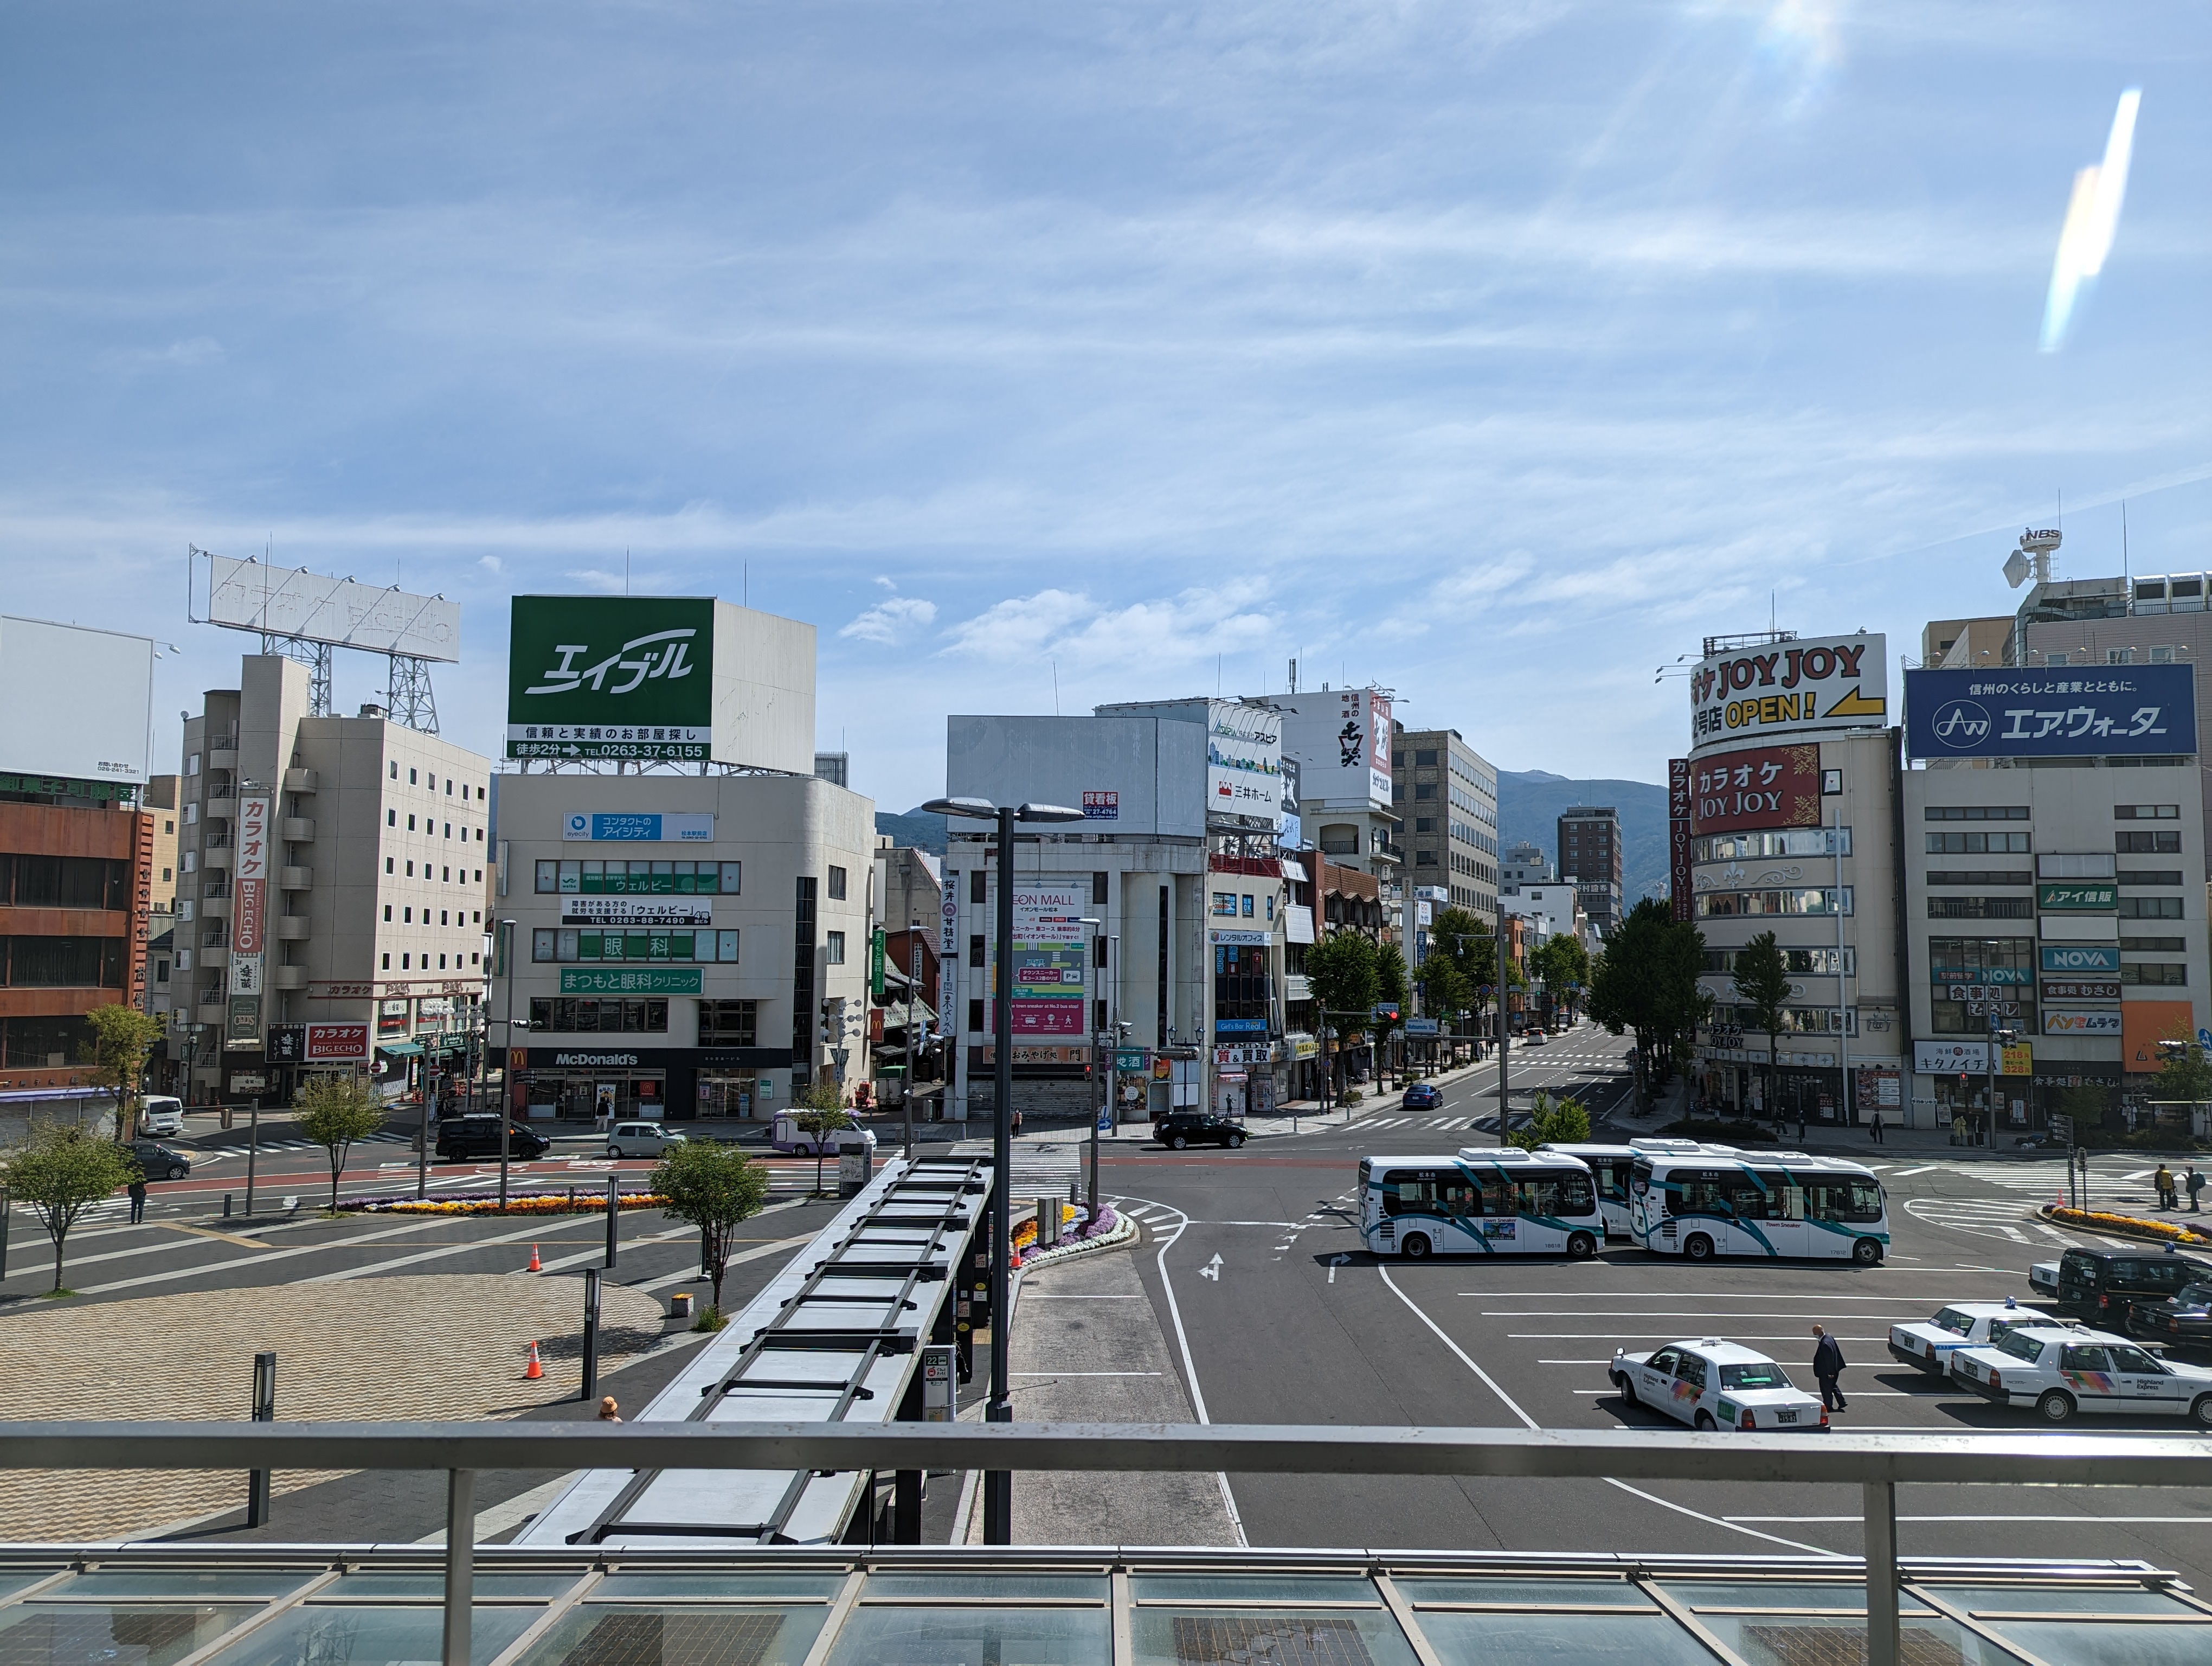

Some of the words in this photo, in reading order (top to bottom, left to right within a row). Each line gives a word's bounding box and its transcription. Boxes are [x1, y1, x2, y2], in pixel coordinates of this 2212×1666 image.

[2026, 529, 2060, 541] NBS
[524, 629, 697, 695] エイブル
[1716, 652, 1779, 701] JOY
[1782, 644, 1866, 689] JOY
[1969, 680, 2138, 696] 信州のくらしと産業とともに。
[1351, 693, 1359, 717] 信州の
[1693, 705, 1723, 738] 2号店
[1725, 691, 1817, 729] OPEN!
[525, 726, 697, 741] 信頼と実績のお部屋探し
[1238, 730, 1255, 739] 株式会社
[1254, 731, 1277, 745] アスピア
[516, 743, 561, 756] 徒歩2分
[584, 748, 599, 756] TEL
[601, 745, 703, 758] 0263-37-6155
[97, 766, 140, 774] 026-241-3321
[1699, 760, 1784, 796] カラオケ
[1234, 785, 1272, 803] 三井ホーム
[1672, 760, 1687, 817] カラオケ
[1084, 792, 1117, 805] 貸看板
[1697, 796, 1729, 821] JOY
[1732, 790, 1783, 816] JOY
[602, 817, 651, 825] コンタクトの
[242, 802, 265, 875] カラオケ
[602, 826, 651, 838] アイシティ
[1675, 821, 1686, 853] JOY
[1675, 854, 1687, 886] JOY
[616, 881, 672, 892] ウェルビー
[943, 879, 956, 902] 桜井
[242, 881, 256, 907] BIG
[1012, 894, 1037, 905] EON
[1041, 895, 1075, 905] MALL
[2057, 891, 2112, 902] アイ信販
[631, 905, 694, 916] 「ウェルビー」
[240, 910, 254, 949] ECHO
[1220, 934, 1263, 943] レンタルオフィス
[605, 937, 623, 956] 眼
[650, 937, 669, 956] 科
[1217, 946, 1225, 974] iPhone
[1228, 945, 1238, 962] 修理
[2054, 951, 2110, 968] NOVA
[873, 932, 884, 992] まつもと眼科クリニック
[564, 974, 699, 991] まつもと眼科クリニック
[1941, 972, 1973, 980] 駅前留学
[1982, 970, 2026, 983] NOVA
[330, 985, 372, 995] カラオケ
[1952, 986, 2001, 999] 食事処
[2047, 985, 2077, 995] 食事処
[2081, 984, 2117, 996] むさし
[1970, 1003, 2017, 1016] むさし
[1245, 1021, 1261, 1030] Real
[1708, 1023, 1742, 1036] カラオケ
[313, 1028, 364, 1039] カラオケ
[1708, 1035, 1722, 1047] JOY
[1723, 1036, 1742, 1048] JOY
[312, 1045, 332, 1055] BIG
[334, 1045, 363, 1053] ECHO
[1012, 1050, 1058, 1060] おみやげ処
[1069, 1048, 1081, 1062] 門
[1935, 1046, 1980, 1056] 海鮮肉酒場
[2003, 1051, 2030, 1059] 218円
[555, 1053, 638, 1066] McDonald's
[2004, 1065, 2030, 1074] 328円
[2033, 1076, 2067, 1086] 食事処
[927, 1356, 937, 1364] 22
[1643, 1372, 1659, 1383] Highland
[1643, 1377, 1656, 1387] Express
[2136, 1378, 2164, 1386] Highland
